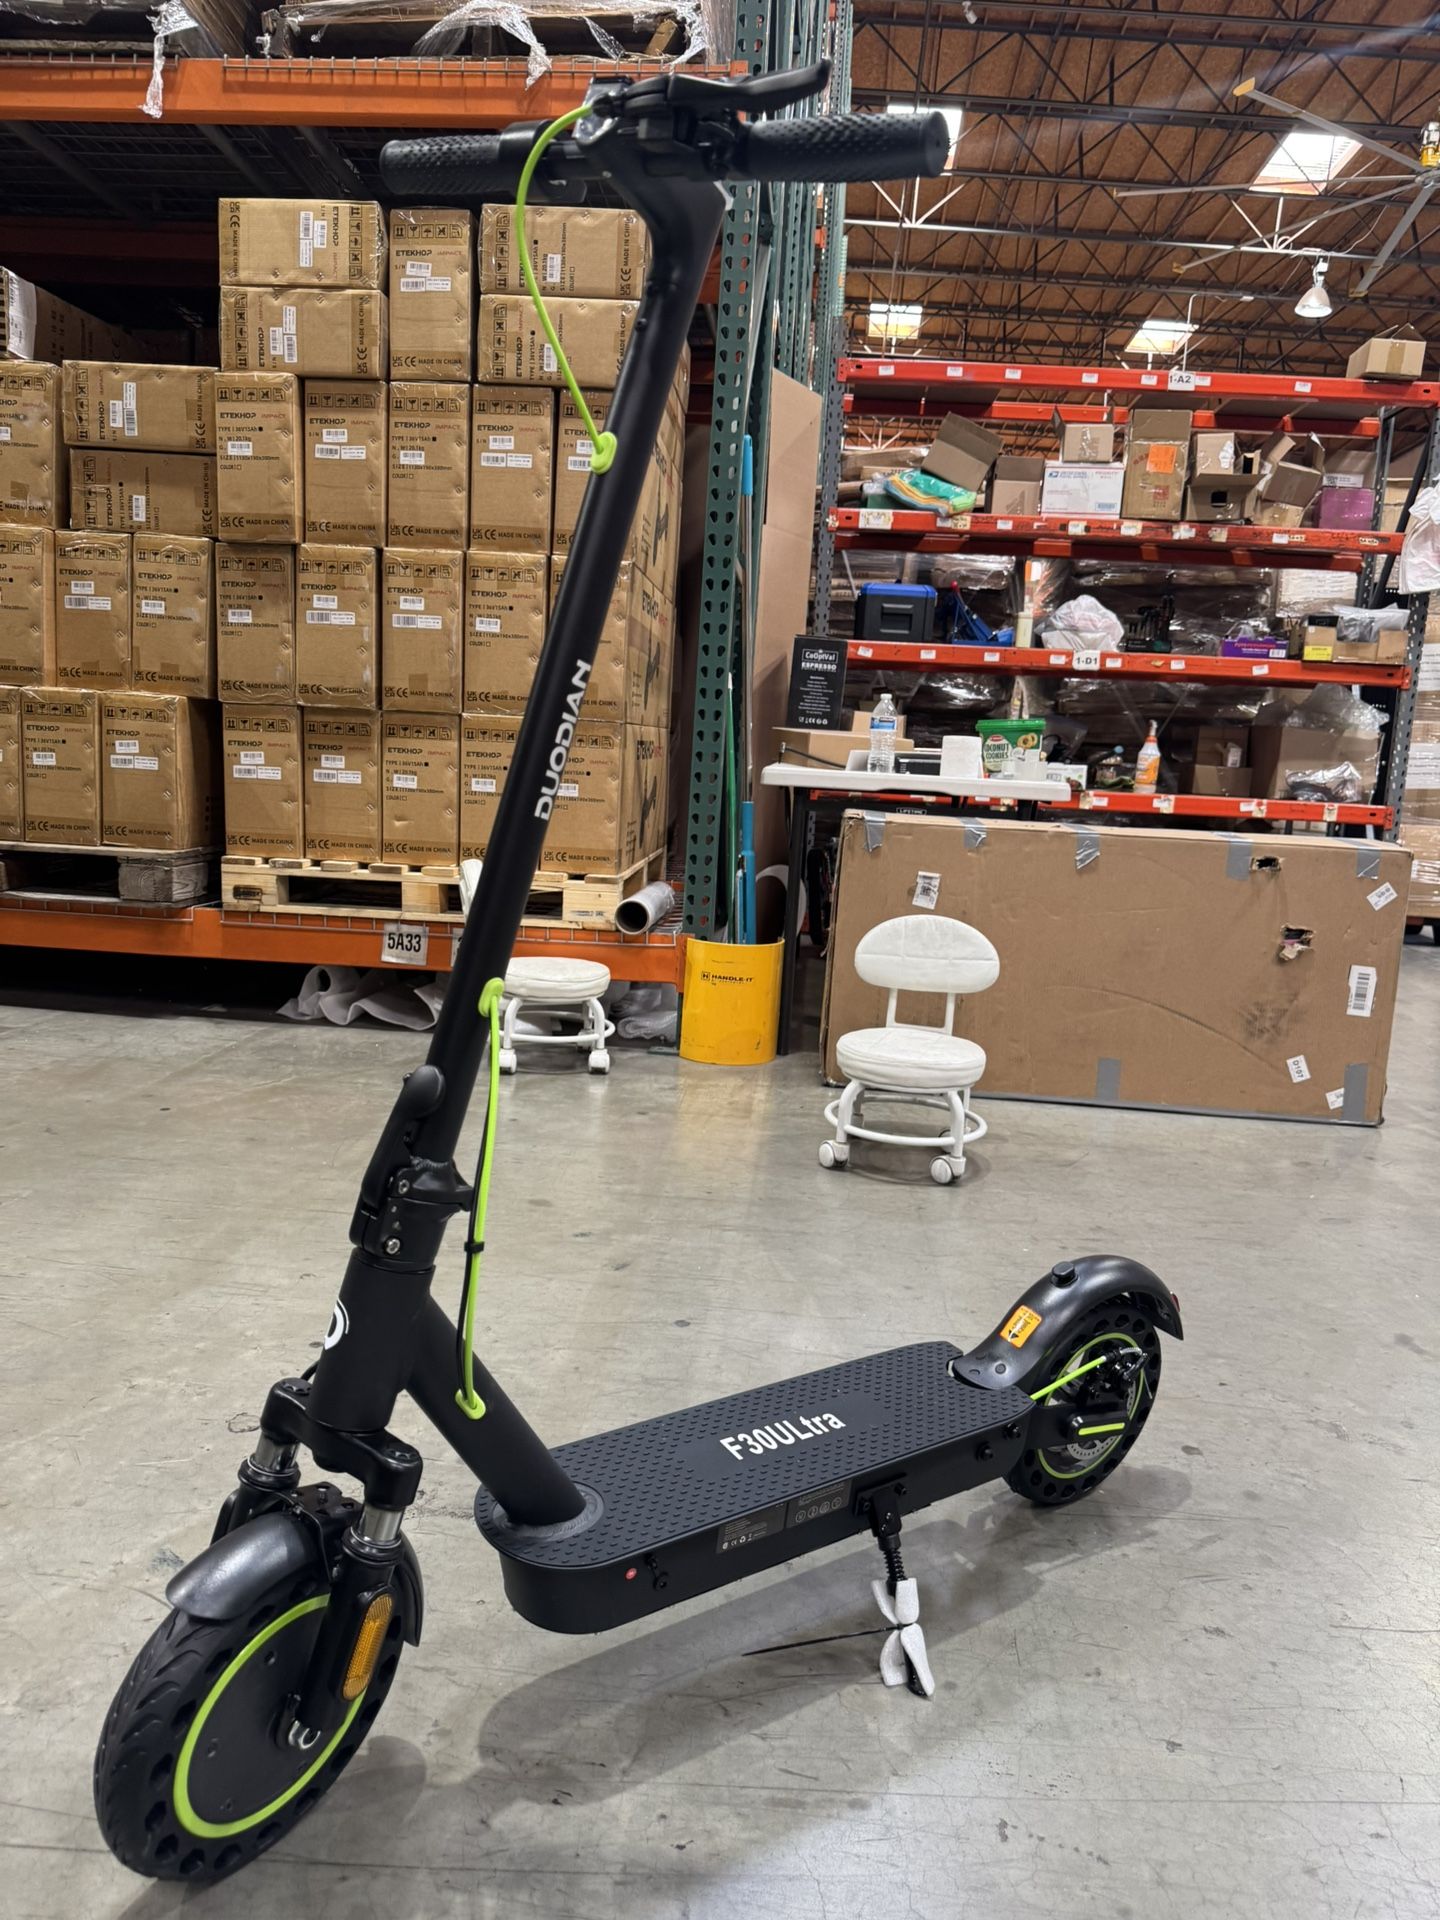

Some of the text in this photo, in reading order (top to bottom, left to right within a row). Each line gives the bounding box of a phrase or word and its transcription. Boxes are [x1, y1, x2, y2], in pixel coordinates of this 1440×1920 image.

[620, 332, 626, 340] IN
[1169, 375, 1192, 383] 1-A2
[564, 428, 589, 436] ETEKH
[204, 482, 209, 490] IN
[60, 568, 93, 576] ETEKHOP
[138, 572, 172, 580] ETEKHOP
[221, 580, 256, 588] ETEKHOP
[472, 590, 507, 598] ETEKHOP
[1076, 657, 1098, 665] 1-D1
[801, 662, 837, 670] ESPRESSO
[534, 659, 592, 821] DUODIAN
[986, 752, 1009, 760] COOKIES
[387, 932, 422, 953] 5A33
[711, 974, 753, 982] HANDLE-IT
[1292, 1060, 1304, 1078] D107
[720, 1413, 847, 1460] F30ULtra
